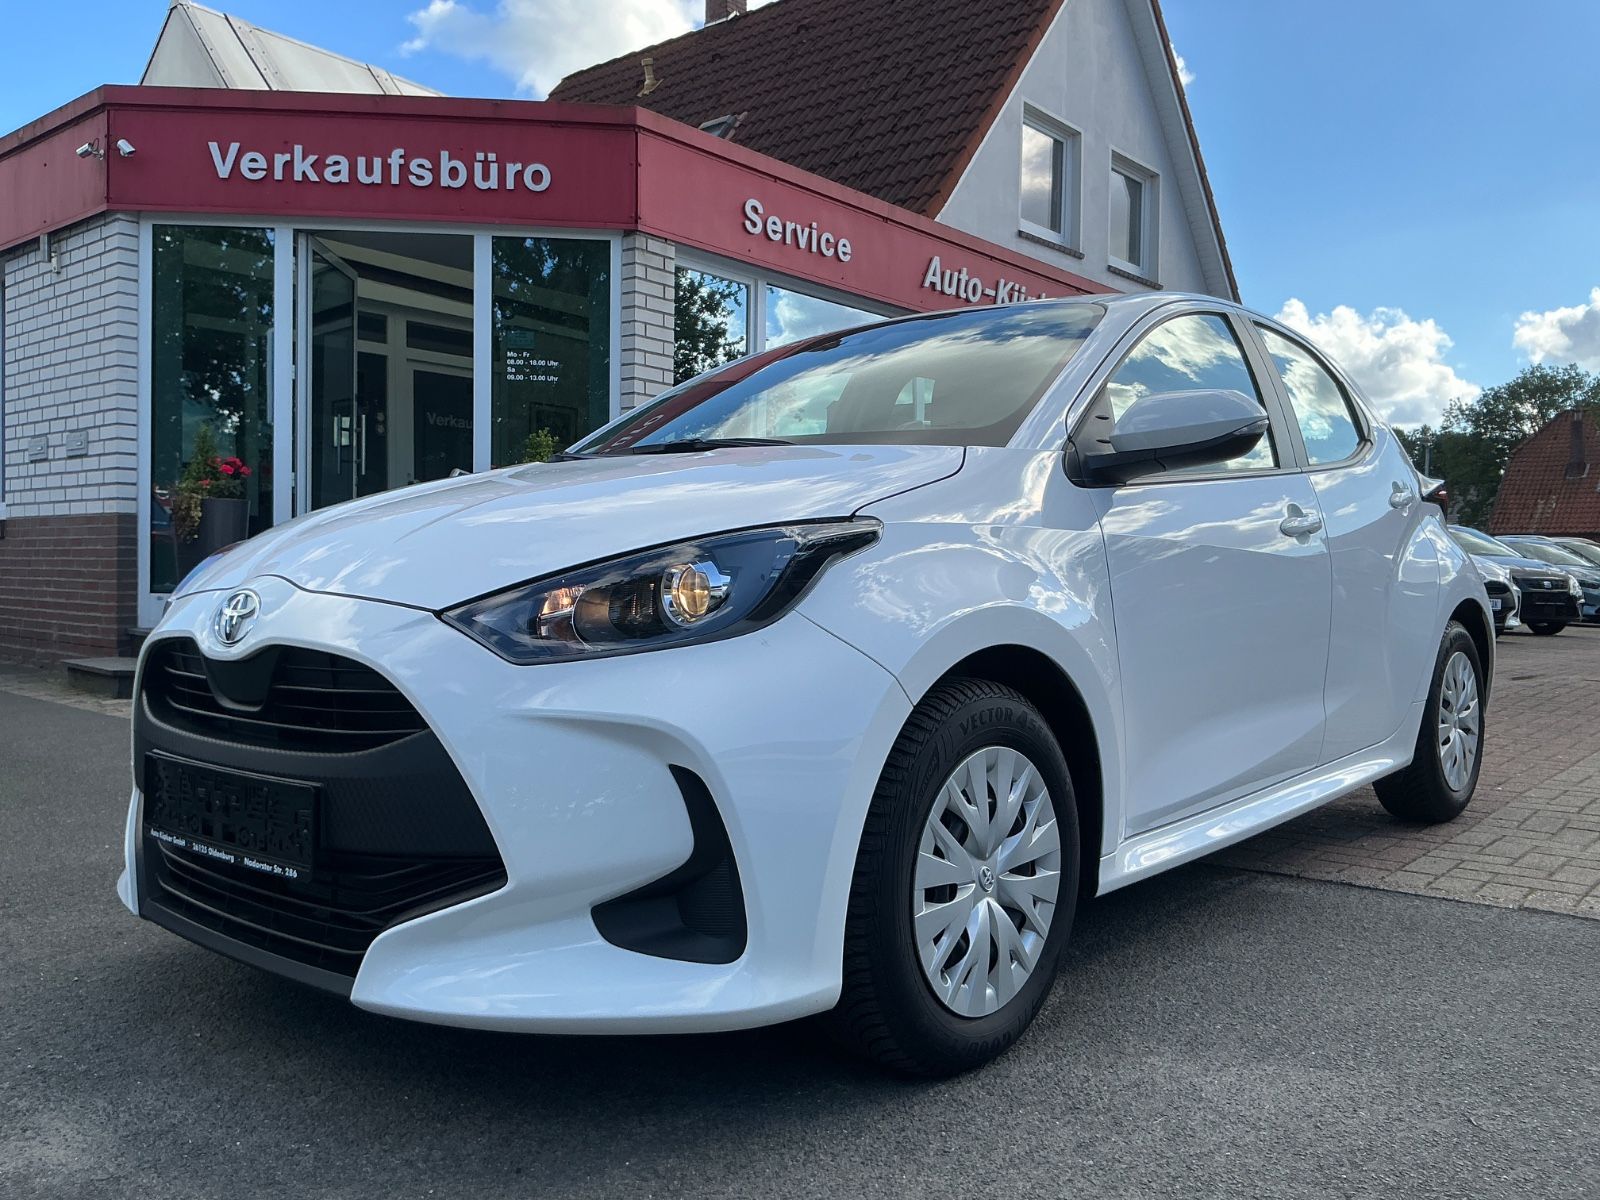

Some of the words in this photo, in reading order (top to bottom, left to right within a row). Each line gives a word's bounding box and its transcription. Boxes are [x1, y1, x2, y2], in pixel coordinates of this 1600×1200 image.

[207, 141, 552, 193] Verkaufsbüro
[742, 198, 853, 263] Service
[959, 706, 1013, 736] VECTOR
[208, 847, 235, 863] Oldenburg
[273, 864, 284, 875] Str.
